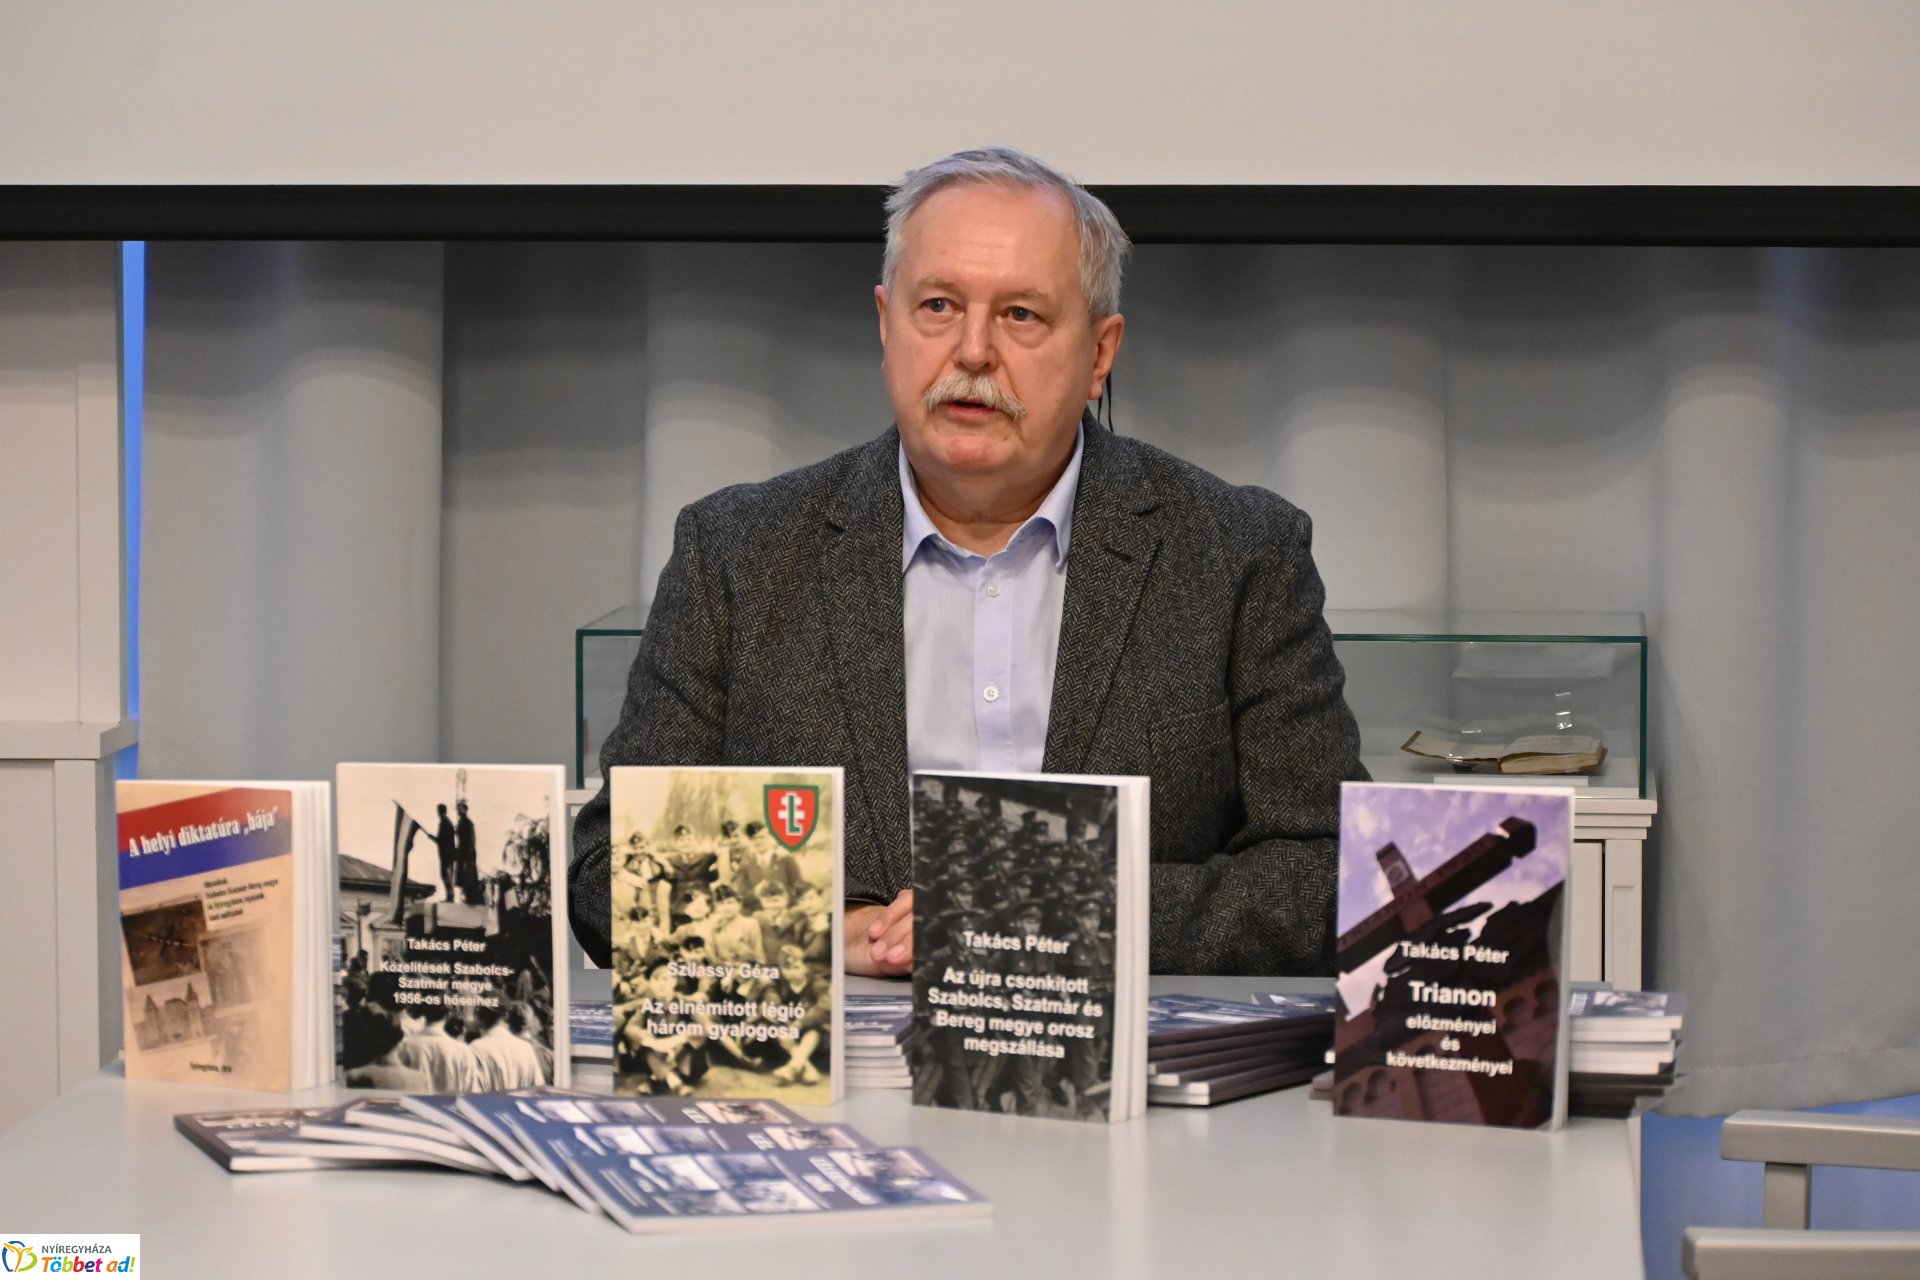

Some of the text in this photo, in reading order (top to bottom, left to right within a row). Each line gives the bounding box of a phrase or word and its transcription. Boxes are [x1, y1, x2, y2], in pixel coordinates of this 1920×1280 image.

[129, 838, 140, 857] A
[140, 829, 177, 855] helyi
[178, 817, 241, 847] diktatúra
[407, 938, 487, 952] Takács Péter
[963, 930, 1070, 955] Takács Péter
[1400, 940, 1510, 964] Takács Péter
[453, 962, 514, 976] Szabolcs-
[739, 963, 780, 980] Géza
[942, 966, 965, 984] Az
[969, 969, 1002, 989] újra
[398, 976, 493, 993] Szatmár megye
[1408, 980, 1497, 1007] Trianon
[393, 991, 441, 1005] 1956-os
[641, 998, 664, 1014] Az
[762, 1001, 805, 1022] légió
[928, 987, 1103, 1017] Szabolcs, Szatmár és
[647, 1018, 800, 1042] három gyalogosa
[935, 1010, 1095, 1039] Bereg megye orosz
[1405, 1013, 1497, 1037] előzményei
[963, 1037, 1065, 1059] megszállása
[1440, 1034, 1461, 1051] és
[1386, 1051, 1513, 1077] következményei
